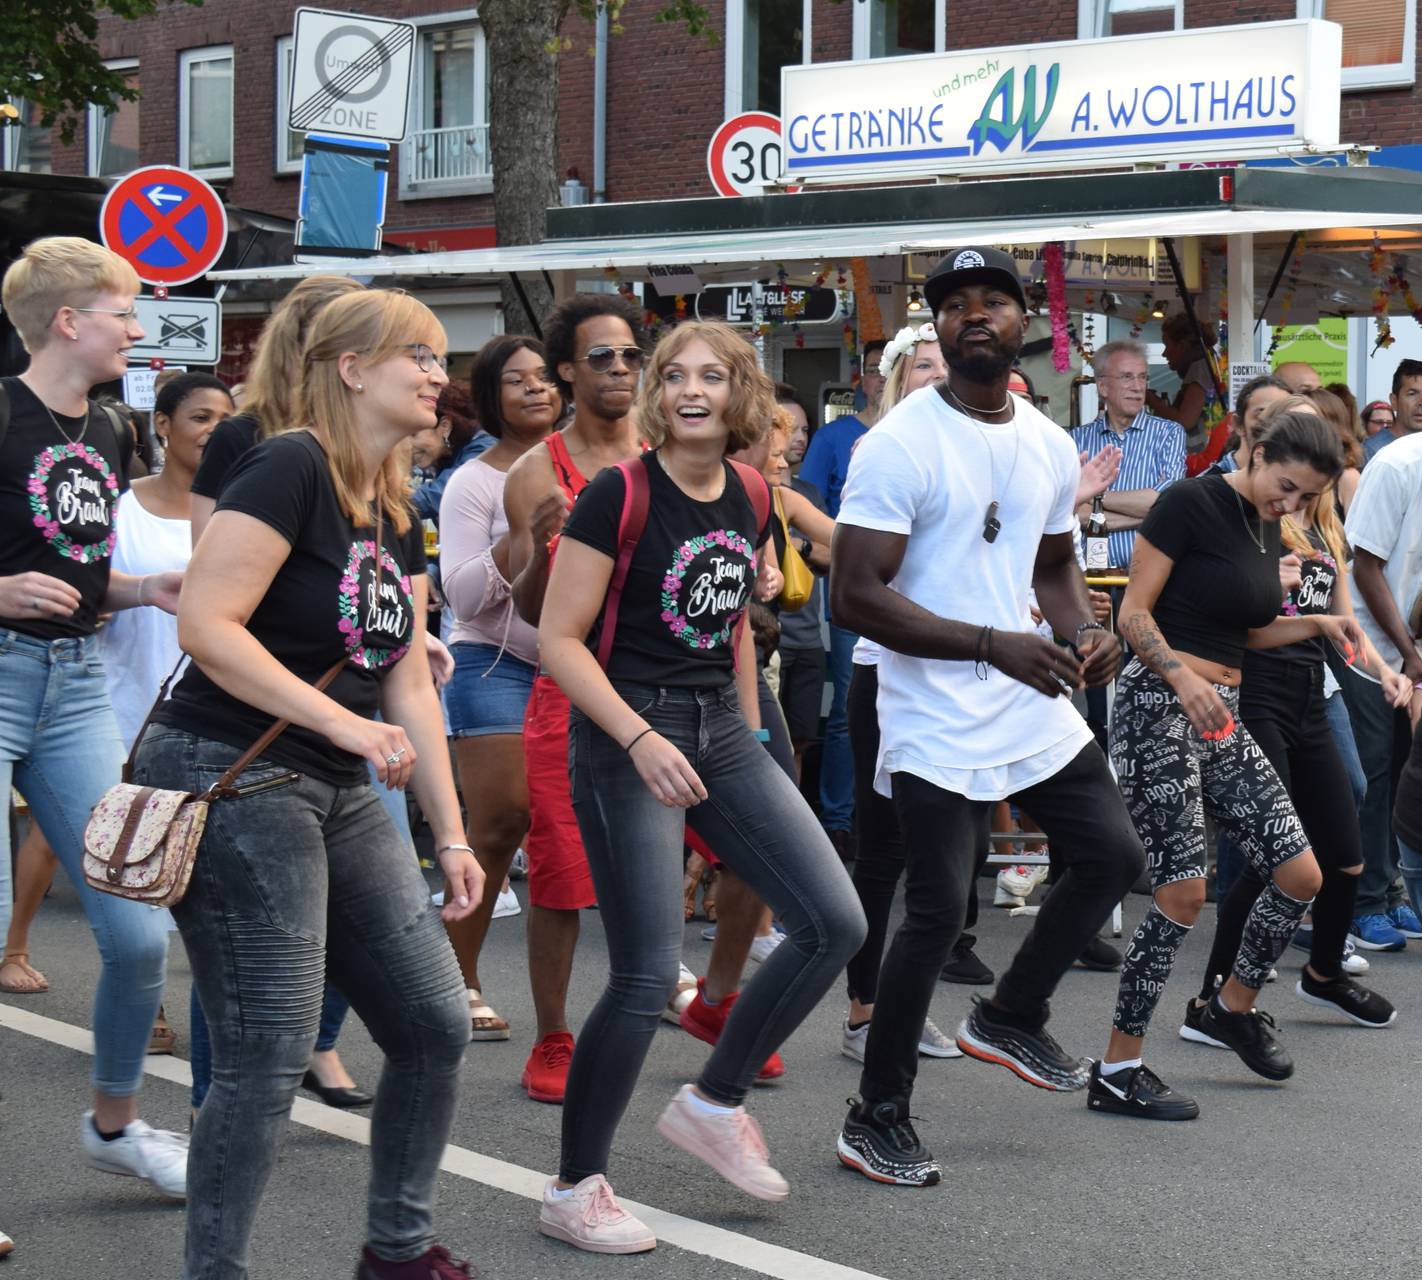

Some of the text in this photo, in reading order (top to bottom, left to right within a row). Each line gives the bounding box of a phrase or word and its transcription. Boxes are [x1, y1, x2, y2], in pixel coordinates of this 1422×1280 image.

[932, 56, 1000, 98] und mehr
[319, 107, 378, 131] ZONE
[1070, 74, 1297, 133] A. WOLTHAUS
[788, 103, 943, 154] GETRÄNKE
[730, 140, 781, 184] 30
[1013, 247, 1034, 260] Cuba
[1231, 365, 1268, 376] COCKTAILS
[55, 481, 110, 527] Braut
[67, 468, 102, 498] Team
[710, 556, 747, 584] Team
[686, 573, 748, 618] Braut
